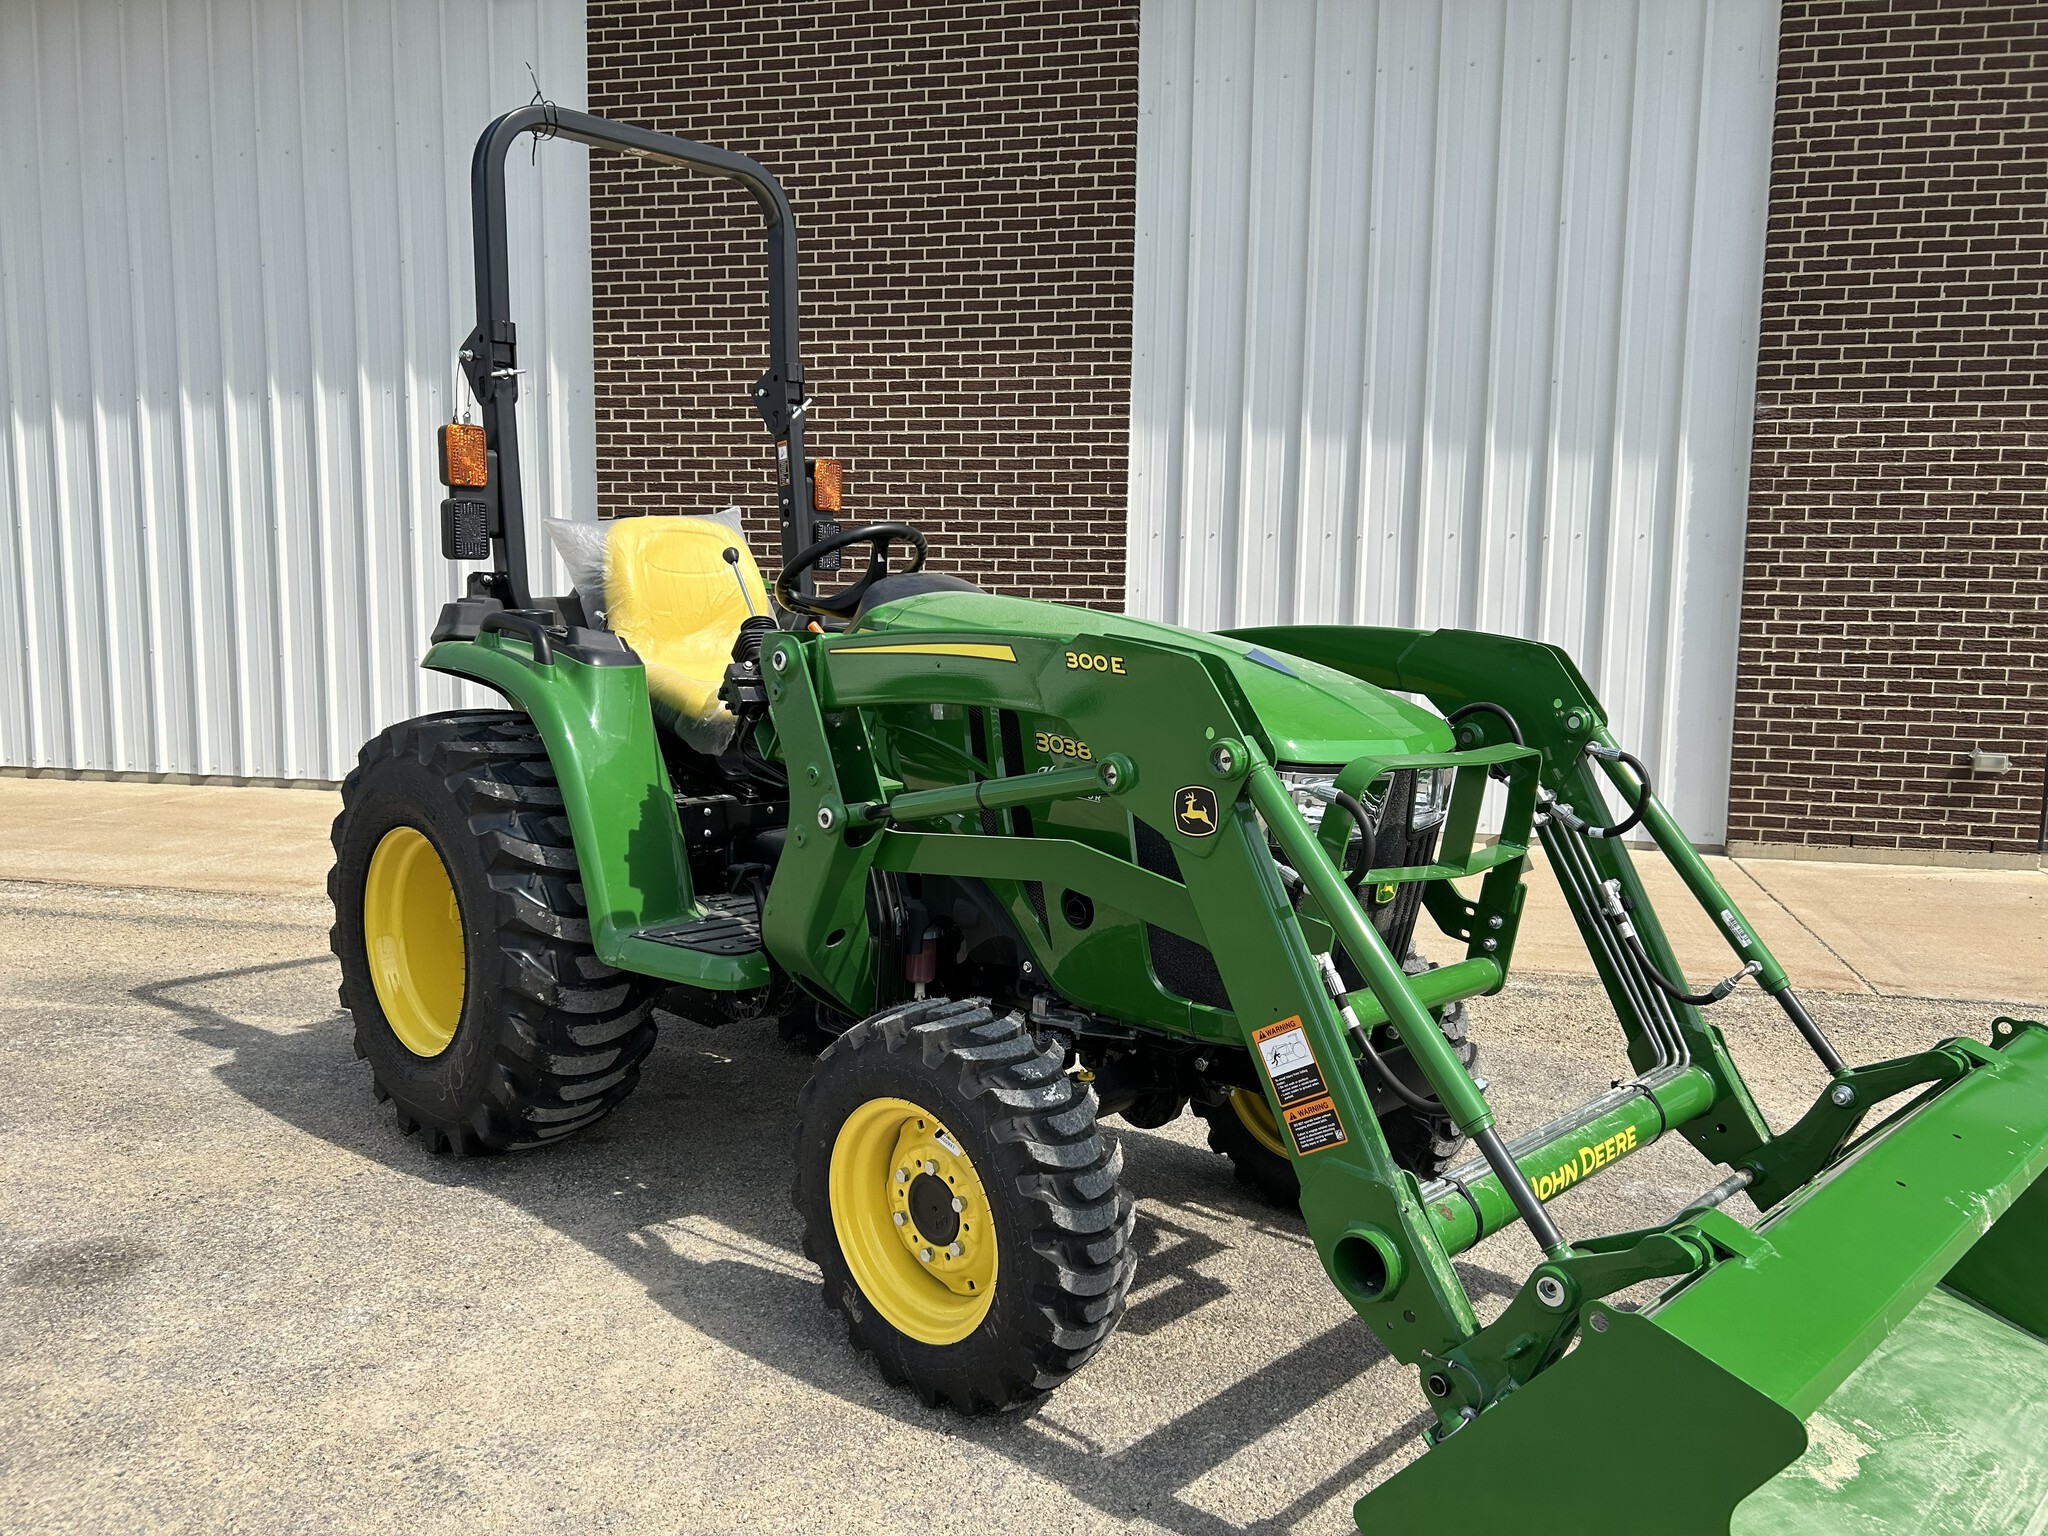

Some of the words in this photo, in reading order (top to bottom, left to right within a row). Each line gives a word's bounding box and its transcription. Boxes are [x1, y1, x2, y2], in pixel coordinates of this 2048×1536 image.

[1035, 732, 1093, 761] 3038
[1265, 1020, 1296, 1037] WARNING
[1297, 1102, 1329, 1117] WARNING
[1578, 1125, 1638, 1177] DEERE
